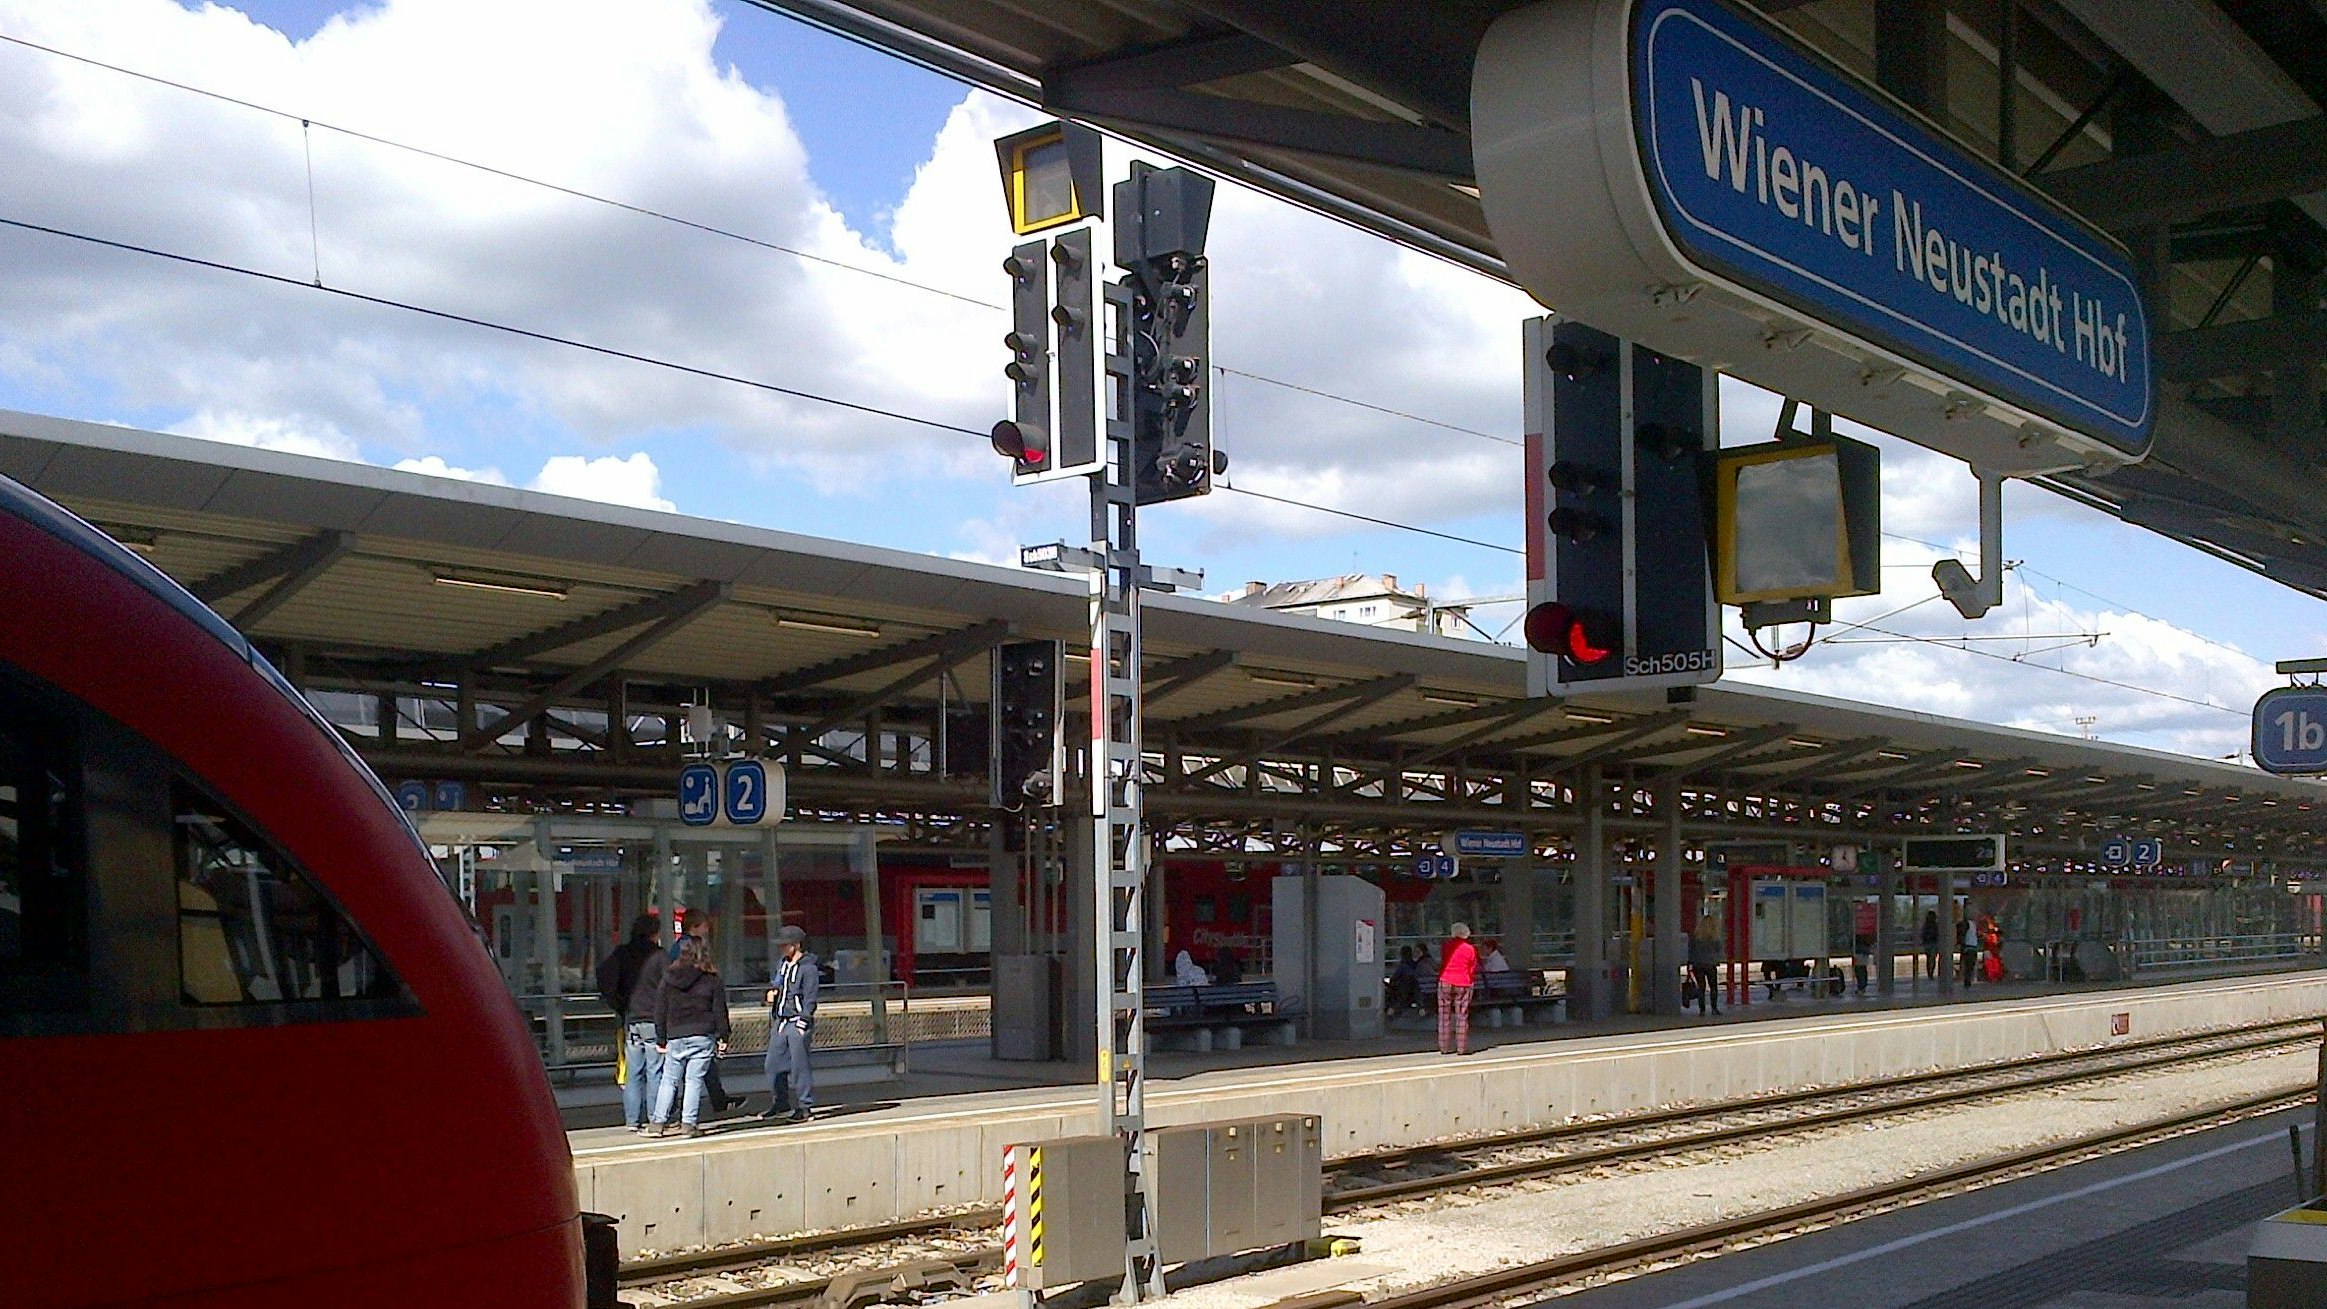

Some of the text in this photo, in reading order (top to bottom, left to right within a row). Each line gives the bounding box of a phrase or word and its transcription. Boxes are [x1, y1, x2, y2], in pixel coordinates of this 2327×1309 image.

[1691, 76, 2128, 385] Wiener Neustadt Hbf
[1625, 649, 1717, 675] Sch505H
[2275, 710, 2325, 751] 1b
[737, 774, 754, 811] 2
[1440, 861, 1449, 872] 4
[2138, 844, 2150, 860] 2
